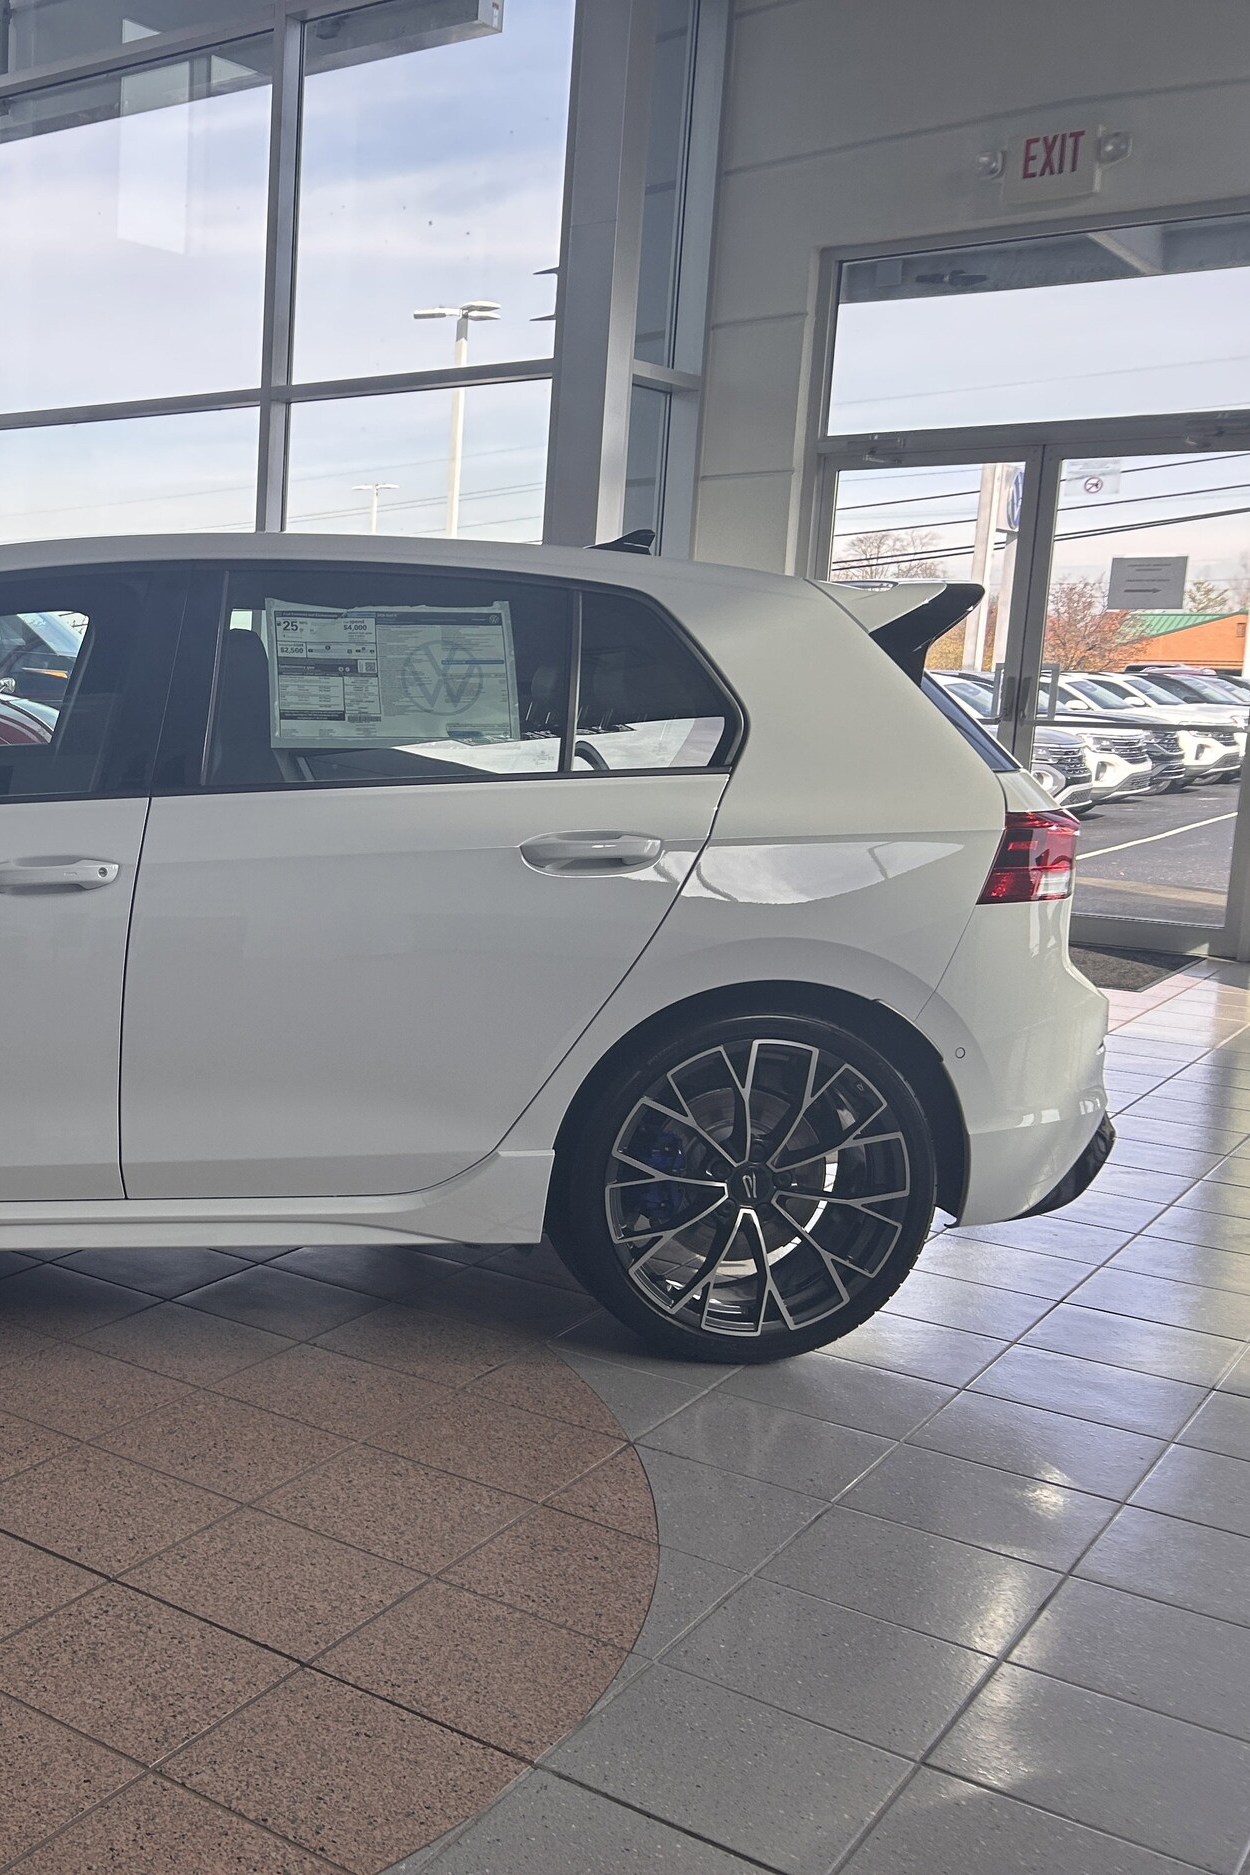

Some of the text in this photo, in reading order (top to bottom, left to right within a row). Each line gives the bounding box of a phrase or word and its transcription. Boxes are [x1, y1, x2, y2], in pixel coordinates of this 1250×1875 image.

[1022, 130, 1085, 179] EXIT
[282, 620, 299, 632] 25
[343, 624, 368, 632] $4,000
